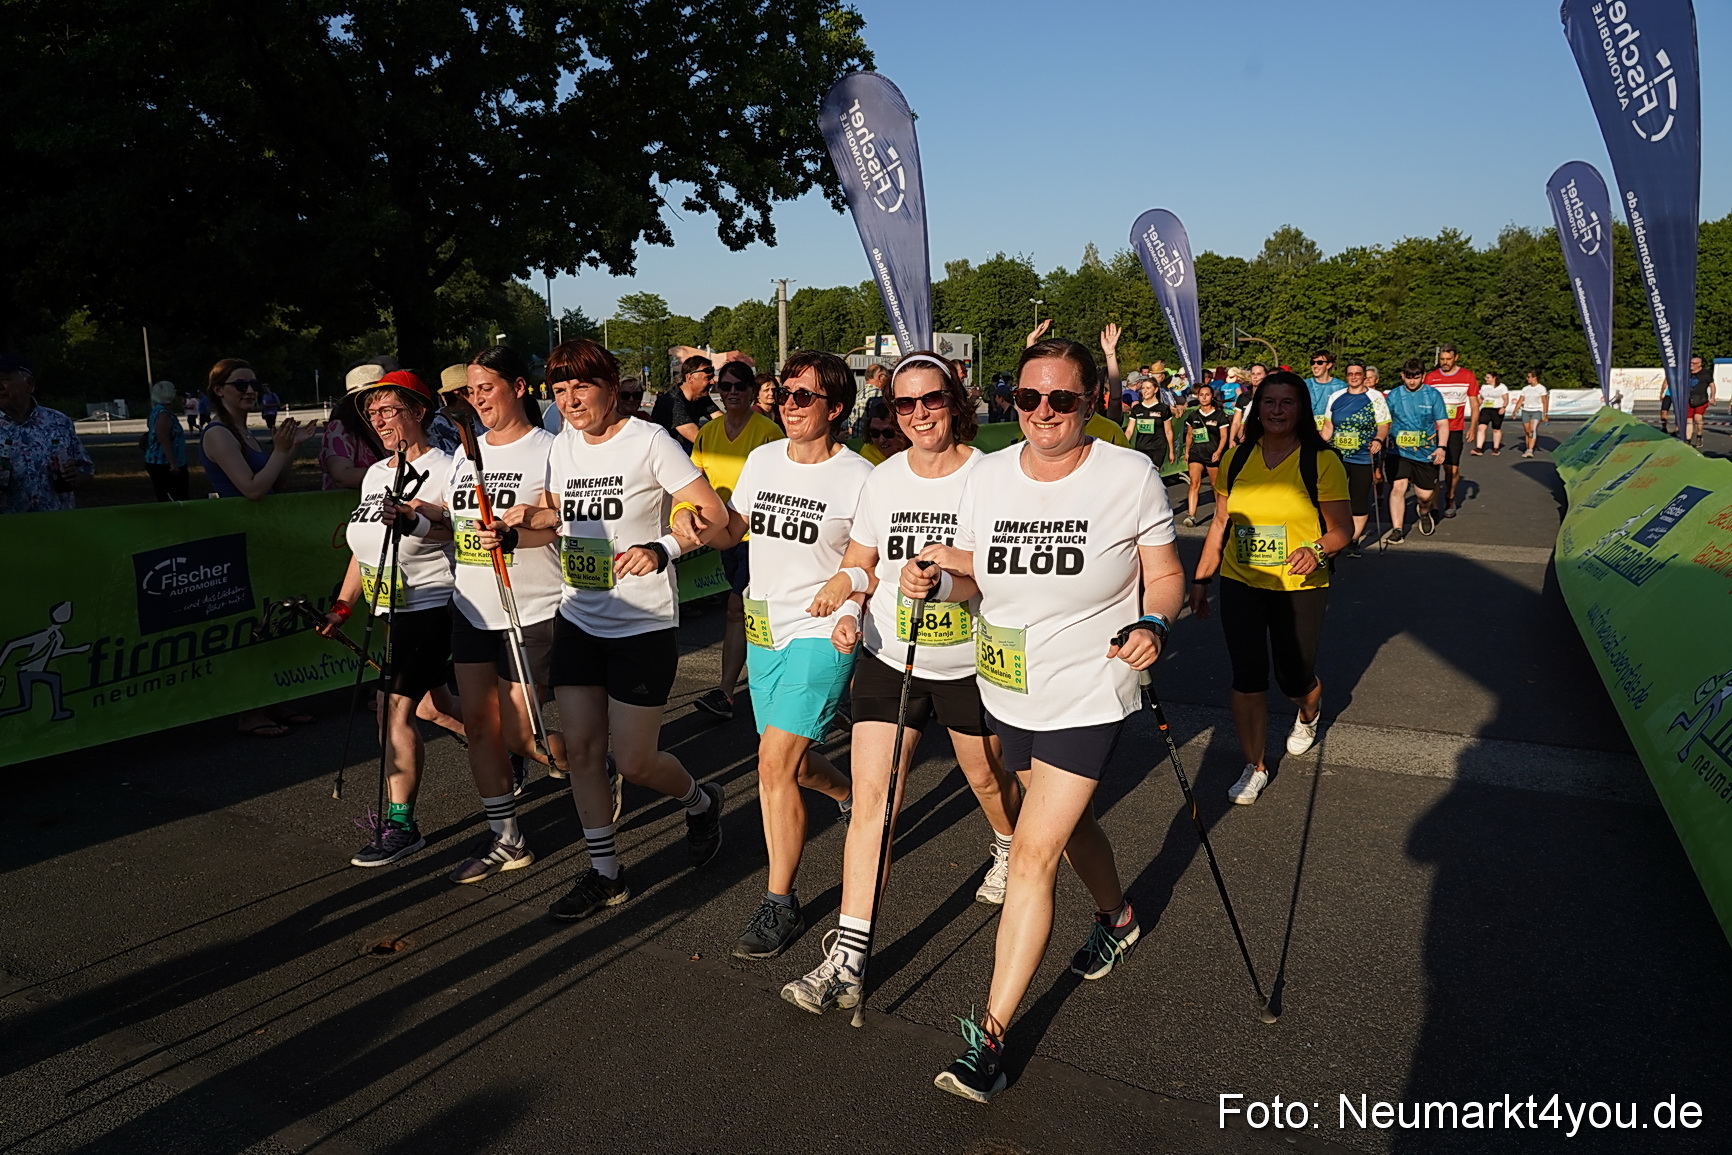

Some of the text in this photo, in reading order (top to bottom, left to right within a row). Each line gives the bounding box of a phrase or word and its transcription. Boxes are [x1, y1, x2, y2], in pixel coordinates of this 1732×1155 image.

[461, 473, 522, 483] UMEHREN
[566, 476, 623, 489] UMKEHREN
[564, 488, 623, 498] WÄRE JETZT AUCH
[756, 490, 827, 513] UMKEHREN
[563, 497, 623, 522] BLÖD
[754, 502, 823, 522] WÄRE JETZT AUCH
[750, 511, 818, 544] BLÖD
[890, 524, 914, 533] WÄRE
[994, 520, 1088, 534] UMKEHREN
[992, 533, 1086, 544] WÄRE JETZT AUCH
[1242, 538, 1277, 552] 1524
[568, 554, 596, 574] 638
[988, 545, 1084, 576] BLÖD
[161, 562, 231, 590] Fischer
[169, 576, 228, 597] AUTOMOBILE
[367, 580, 388, 596] 60
[760, 620, 768, 642] 2022
[960, 611, 968, 636] 2022
[982, 641, 1005, 668] 581
[1014, 655, 1022, 684] 2022
[94, 660, 213, 709] neumarkt
